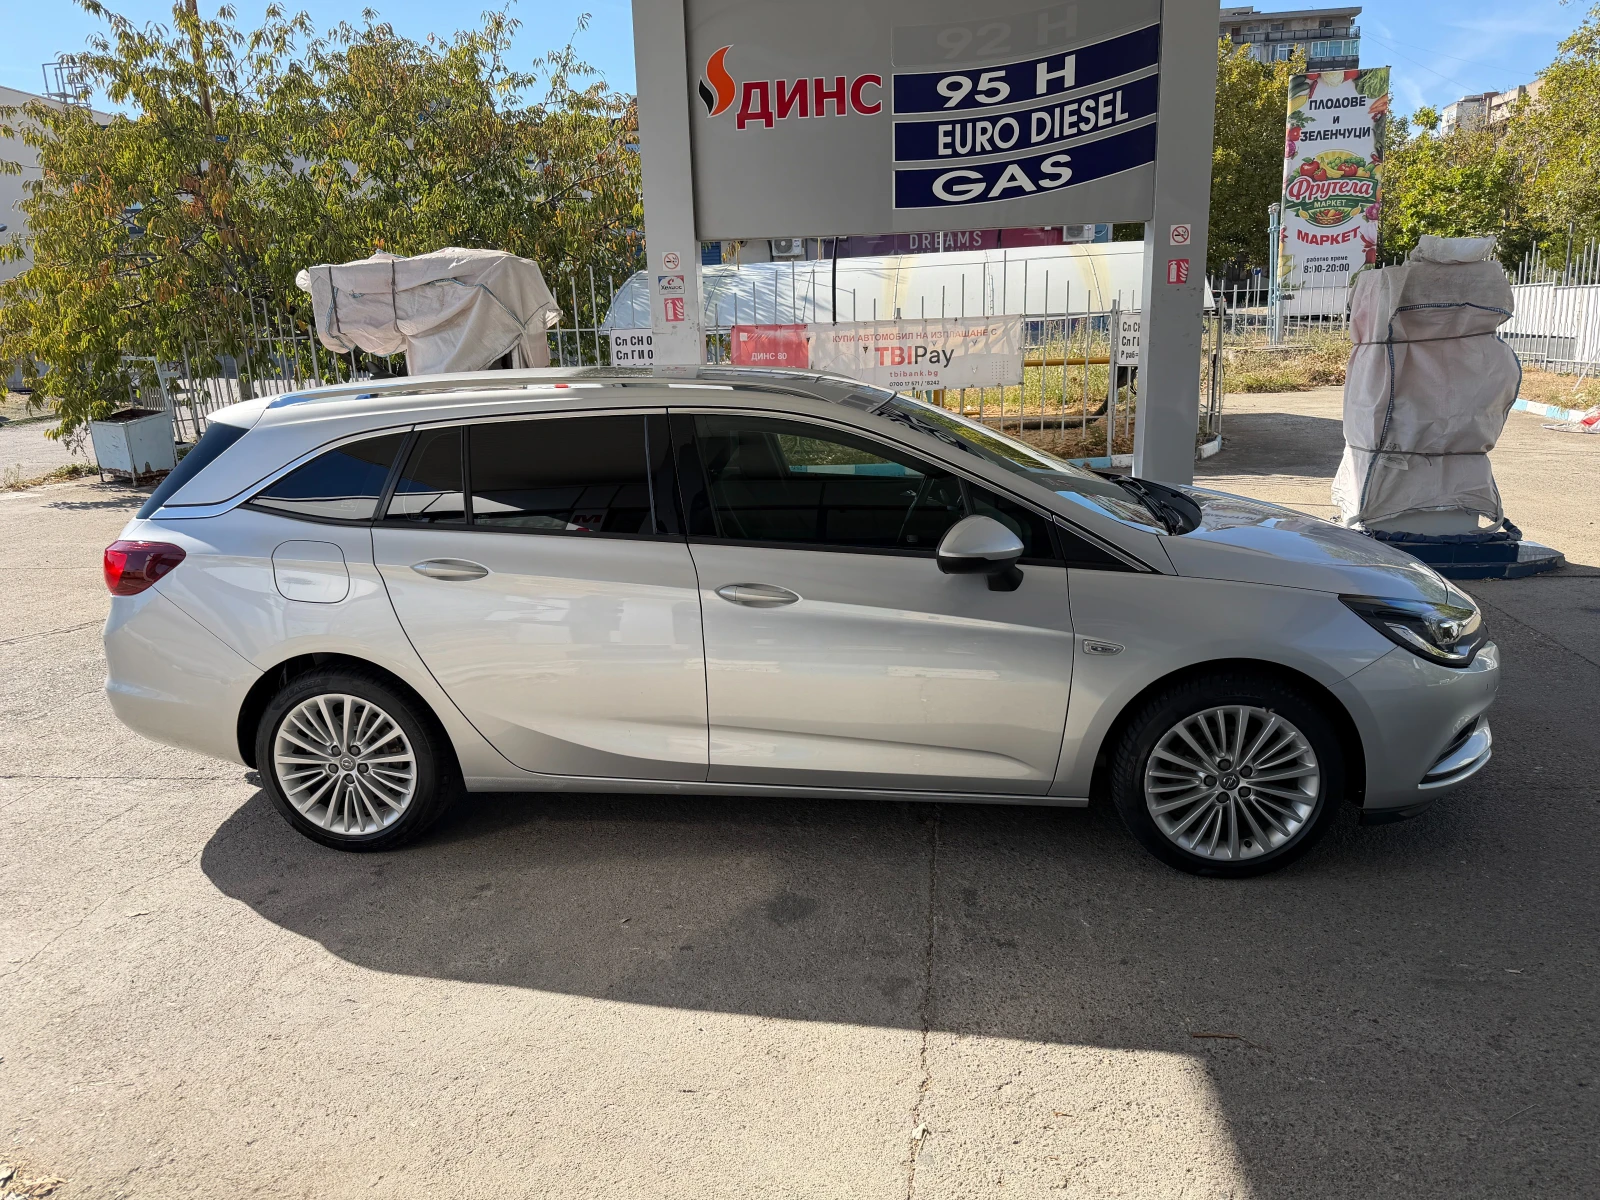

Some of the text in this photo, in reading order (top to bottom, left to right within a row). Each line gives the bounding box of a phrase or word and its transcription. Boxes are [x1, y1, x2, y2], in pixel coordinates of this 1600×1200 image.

[936, 54, 1076, 108] 95 H
[735, 73, 882, 131] ДИНС
[1308, 95, 1367, 111] ПЛОДОВЕ
[938, 90, 1129, 156] EURO DIESEL
[1332, 115, 1340, 125] И
[1300, 126, 1371, 142] ЗЕЛЕНЧУЦИ
[932, 154, 1073, 202] GAS
[1288, 178, 1372, 201] Фрутела
[1313, 199, 1347, 209] МАРКЕТ
[909, 230, 982, 250] DREAMS
[1296, 226, 1361, 246] МАРКЕТ
[1122, 321, 1132, 332] Сл
[615, 336, 628, 346] Сл
[630, 335, 644, 346] СН
[832, 334, 855, 343] КУПИ
[857, 332, 914, 342] АВТОМОБИЛ
[915, 331, 929, 340] НА
[931, 329, 988, 339] ИЗПЛАЩАНЕ
[1121, 335, 1131, 347] Сл
[616, 350, 629, 360] Сл
[751, 352, 788, 361] ДИНС 80
[875, 344, 955, 368] TBIPay
[889, 369, 939, 378] tbibank.bg
